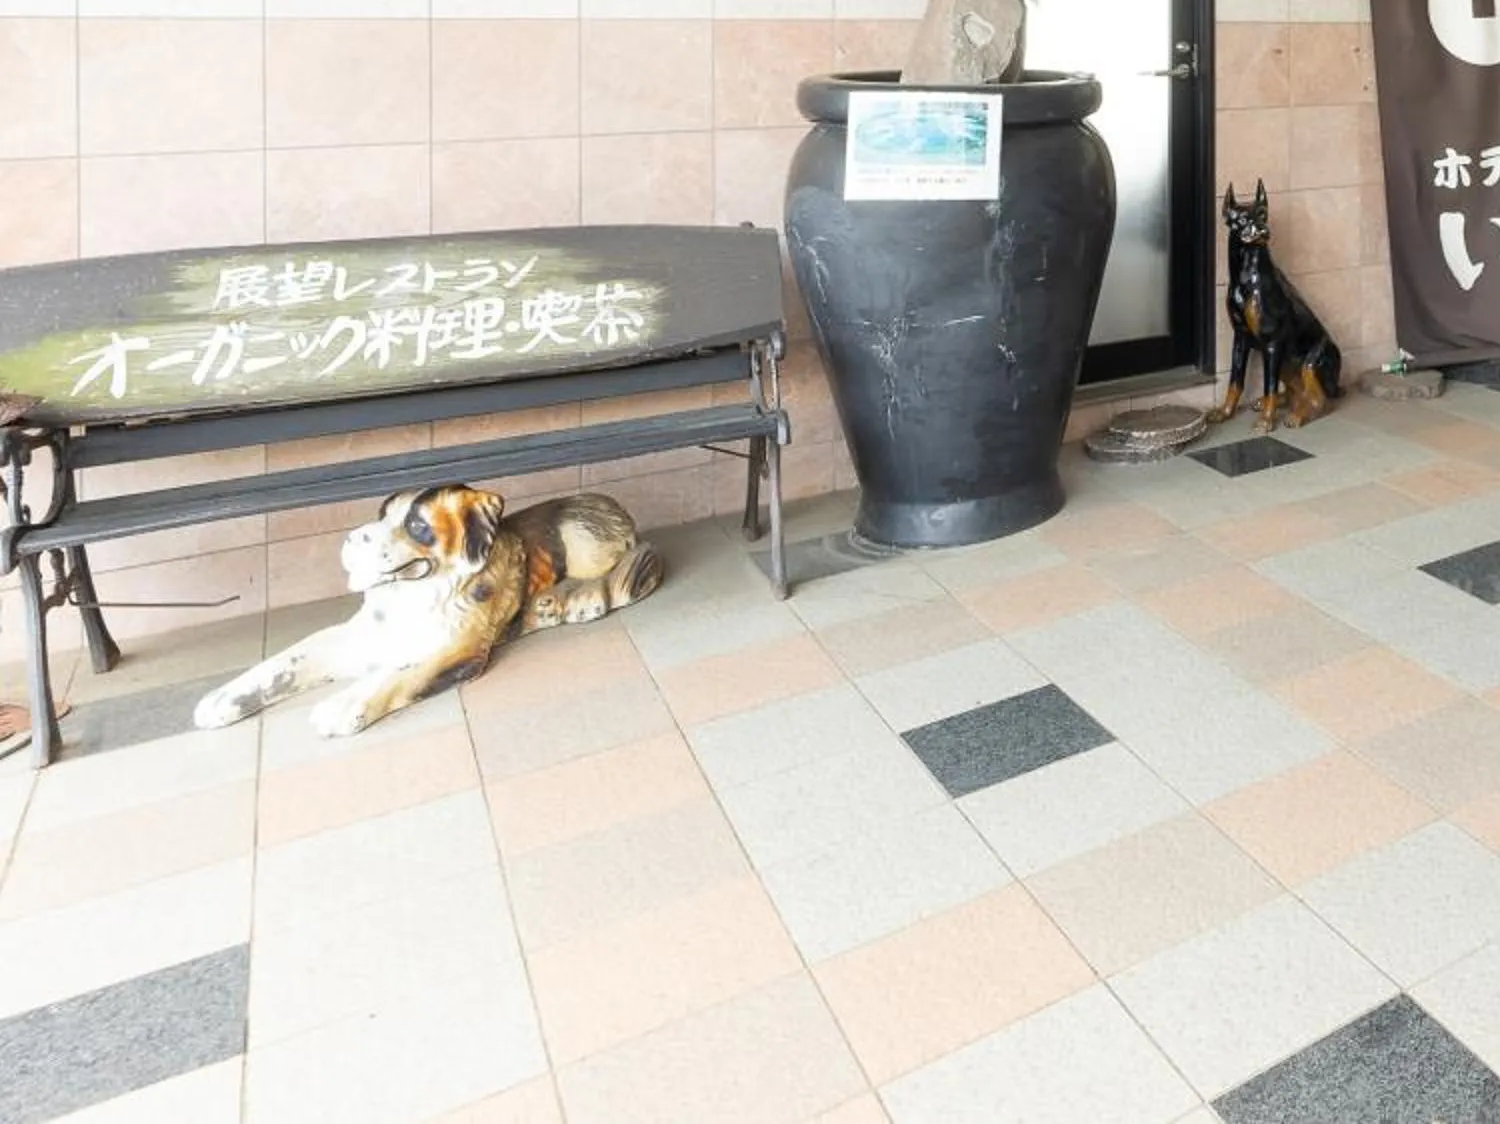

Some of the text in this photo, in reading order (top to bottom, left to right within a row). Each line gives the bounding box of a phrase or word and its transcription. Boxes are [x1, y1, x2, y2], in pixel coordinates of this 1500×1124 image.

[212, 255, 539, 310] 展望レストラン
